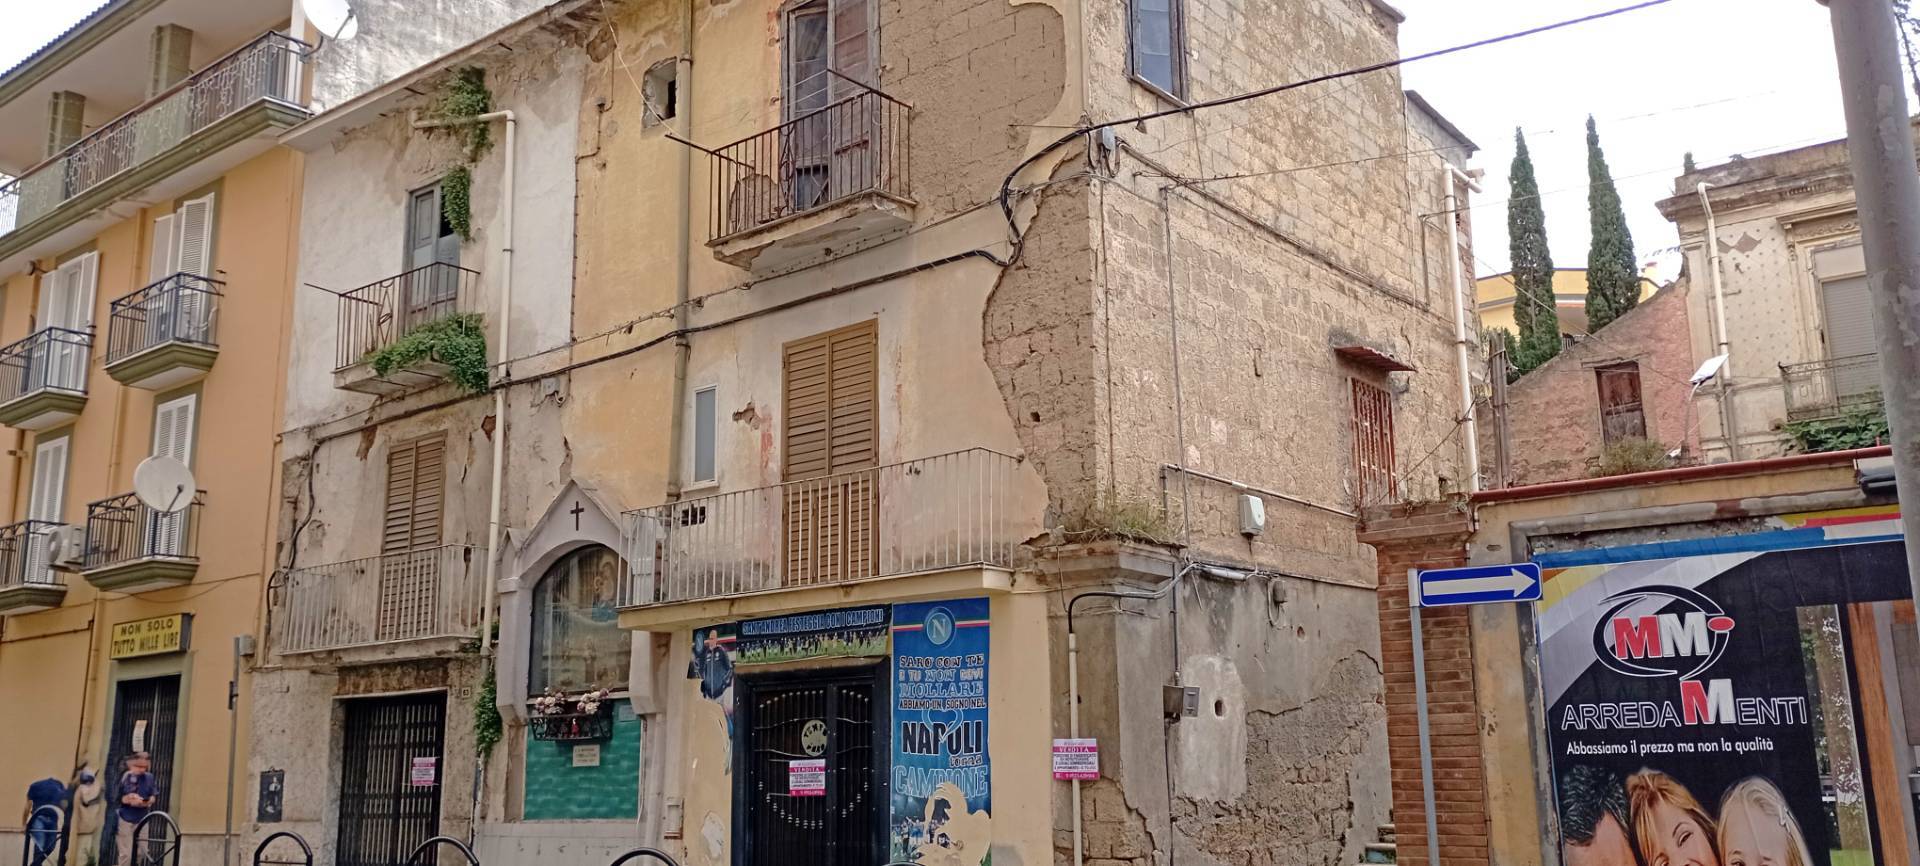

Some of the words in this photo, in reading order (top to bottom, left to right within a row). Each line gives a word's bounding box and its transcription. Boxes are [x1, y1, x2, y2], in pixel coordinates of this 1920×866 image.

[121, 624, 141, 636] NON
[147, 618, 173, 632] SOLO
[826, 612, 842, 628] CON
[113, 638, 135, 655] TUTTO
[140, 634, 159, 651] MILLE
[164, 632, 178, 648] LIRE
[936, 656, 962, 668] CON
[966, 654, 984, 667] TE
[925, 669, 956, 682] NON
[899, 681, 984, 698] MOLLARE
[899, 699, 930, 710] ABBIAMO
[931, 699, 943, 710] UN
[946, 698, 969, 710] SOGNO
[971, 697, 986, 709] NEL
[1561, 678, 1808, 730] ARREDAMENTI
[902, 720, 983, 755] NAPOLI
[1566, 740, 1628, 755] Abbassiamo
[1631, 739, 1637, 754] il
[1640, 742, 1674, 756] prezzo
[1677, 743, 1695, 753] ma
[1697, 742, 1719, 753] non
[1721, 737, 1732, 751] la
[1735, 737, 1774, 755] qualità
